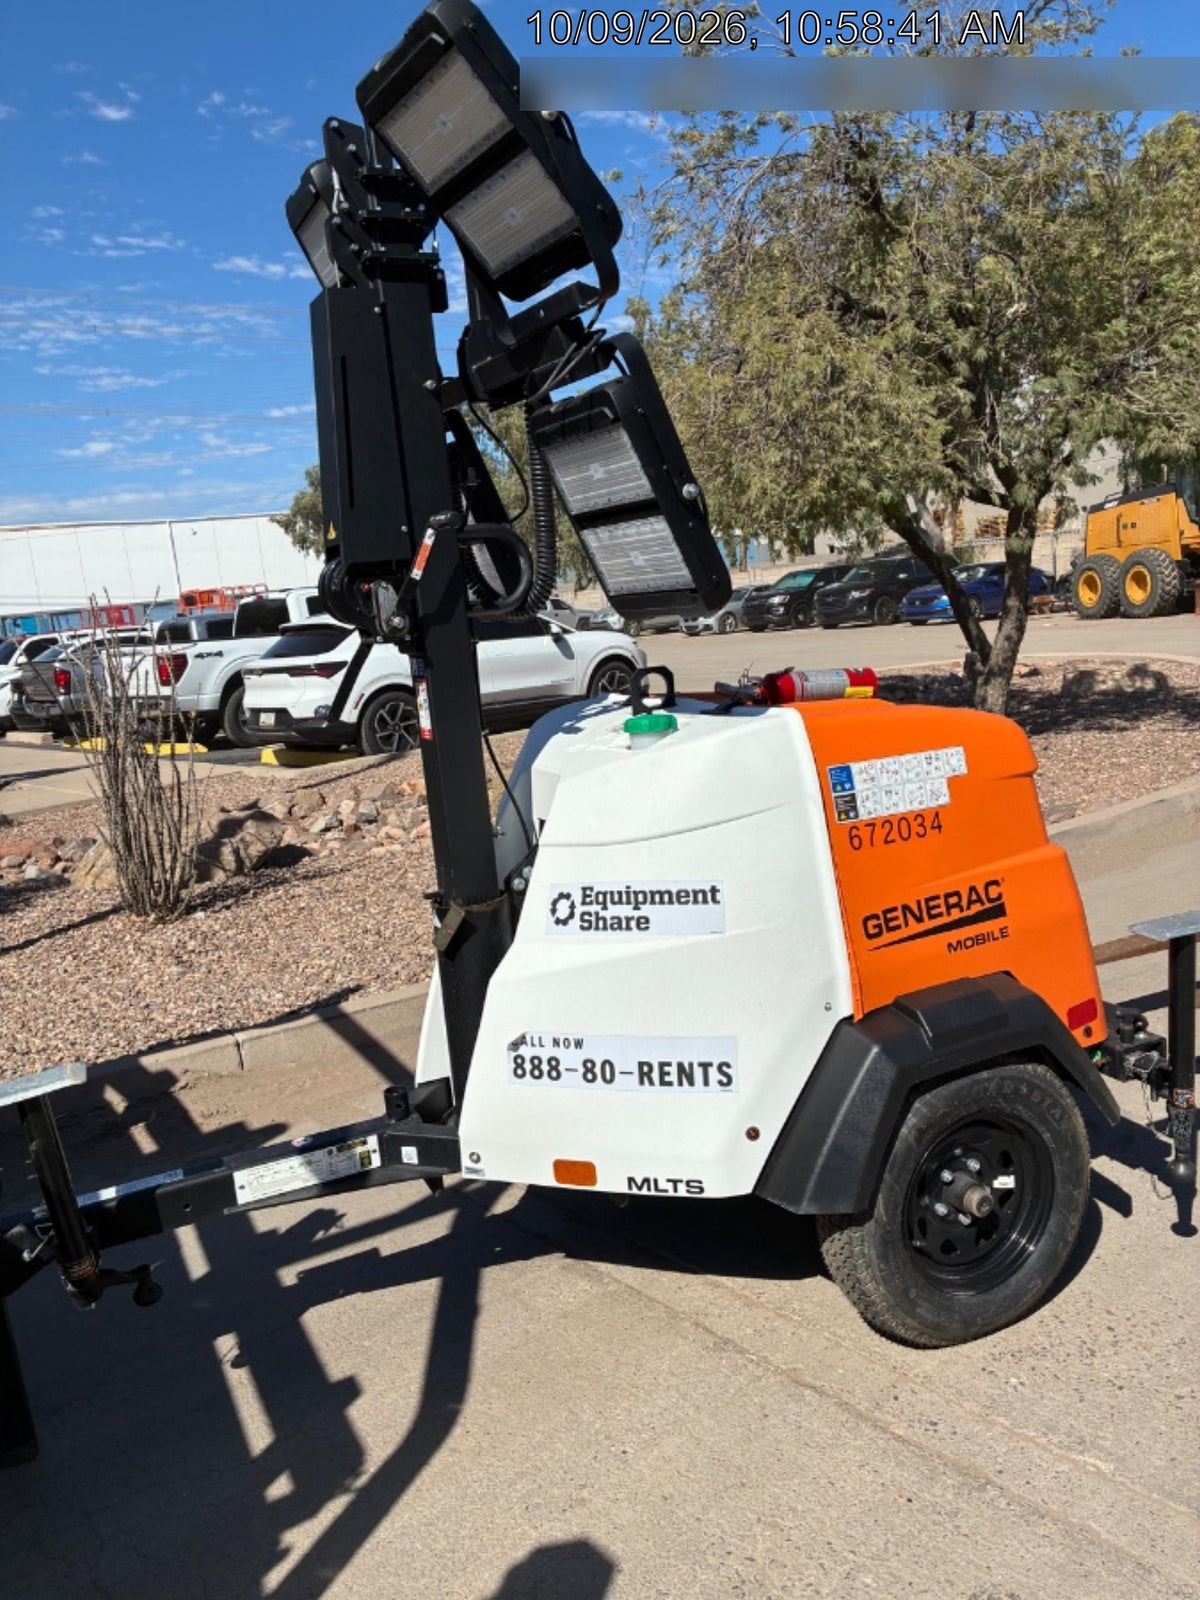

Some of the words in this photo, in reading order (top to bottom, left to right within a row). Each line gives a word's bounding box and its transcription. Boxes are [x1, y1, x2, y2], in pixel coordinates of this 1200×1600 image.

[848, 811, 943, 851] 672034
[580, 885, 721, 911] Equipment
[862, 879, 1004, 940] GENERAC
[579, 911, 650, 931] Share
[947, 926, 1010, 954] MOBILE
[552, 1036, 584, 1050] NOW
[512, 1053, 734, 1088] 888-80-RENTS
[627, 1176, 705, 1195] MLTS
